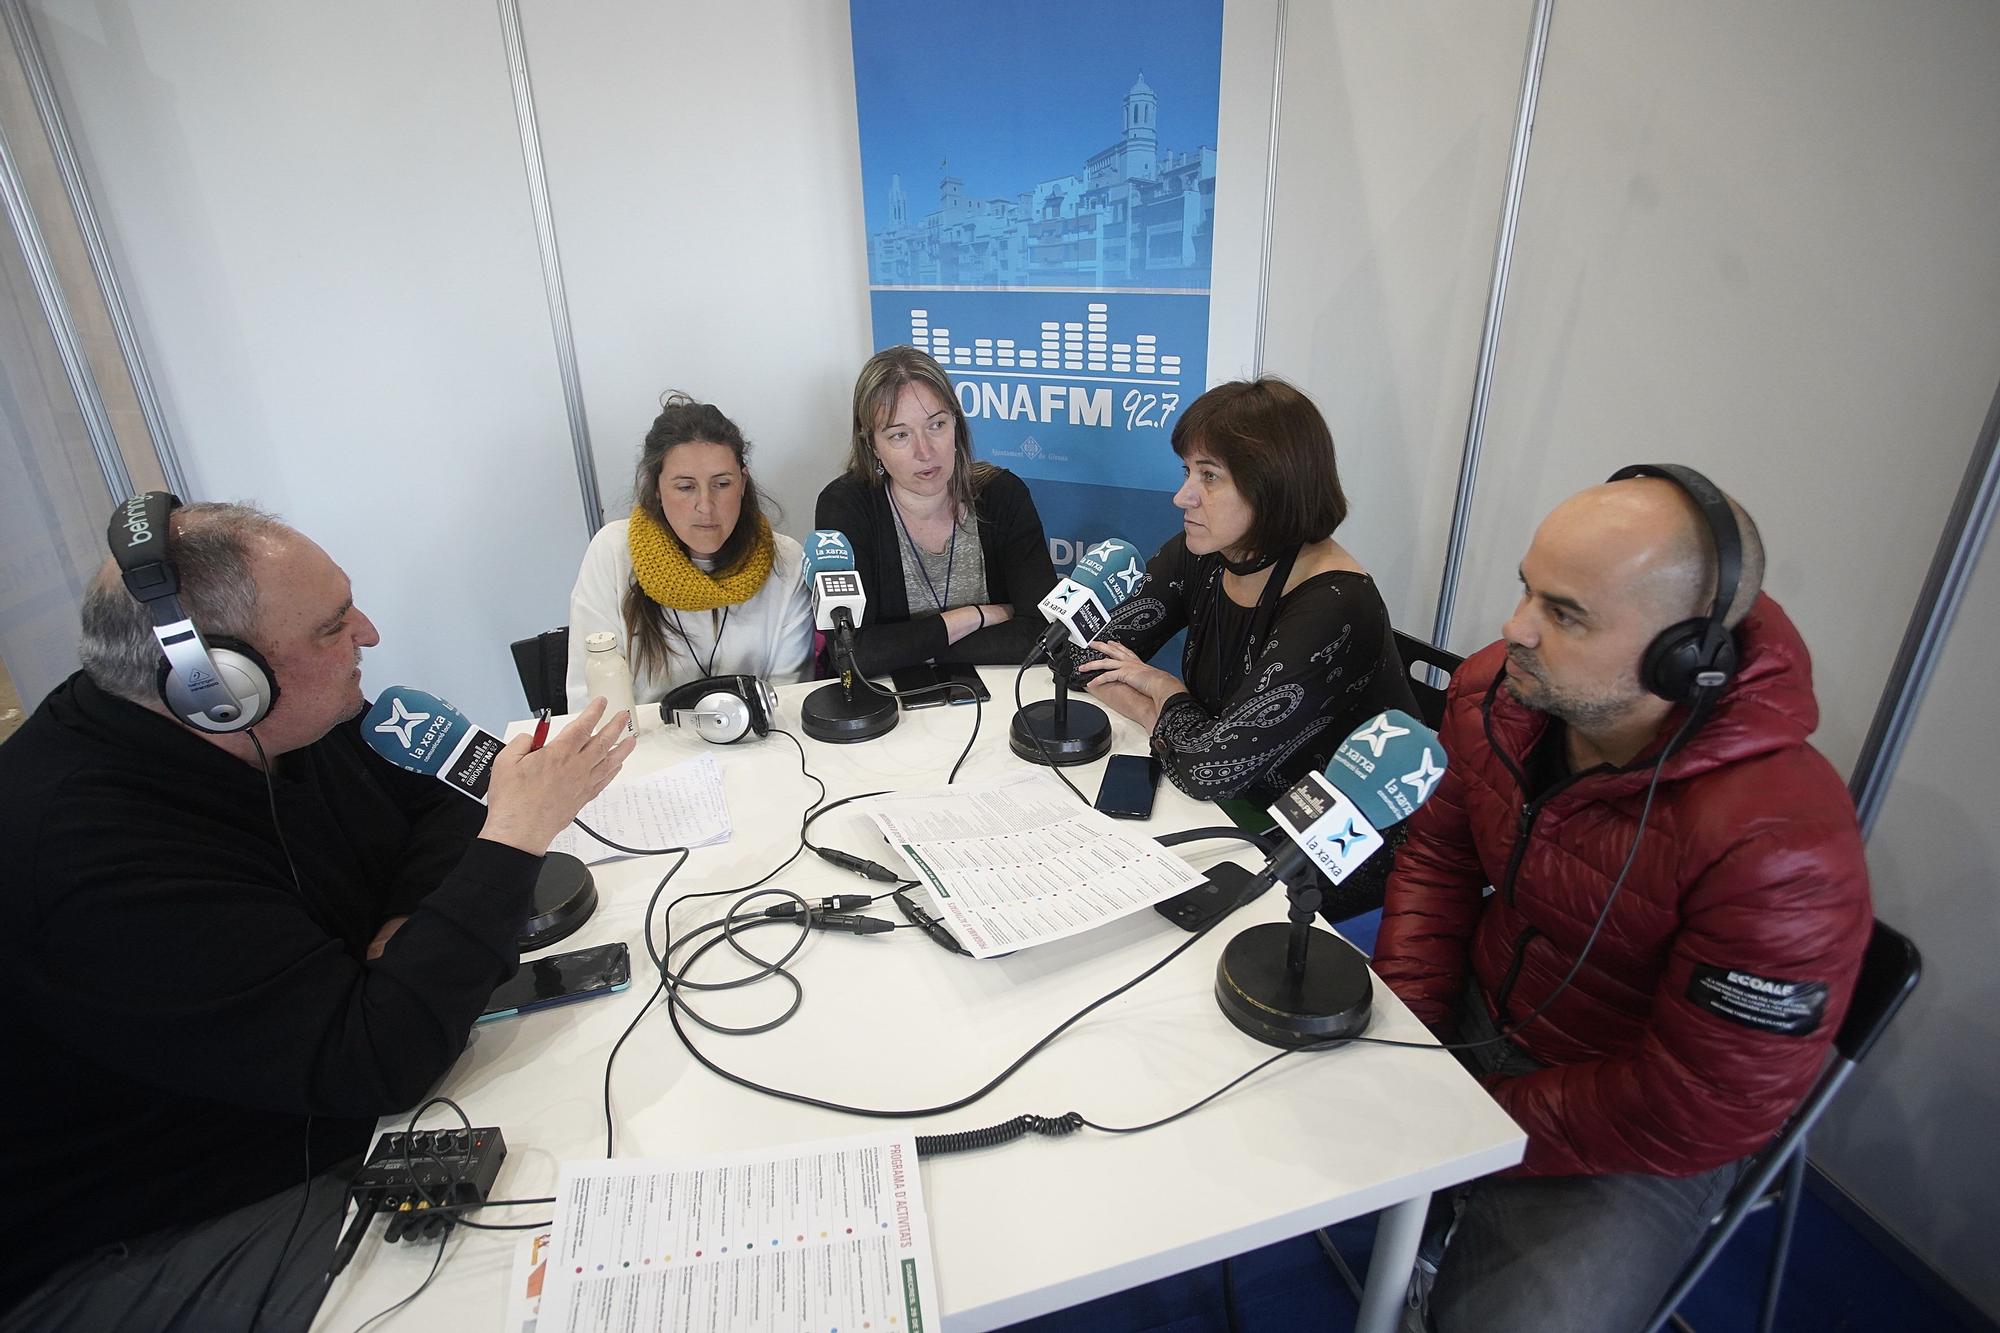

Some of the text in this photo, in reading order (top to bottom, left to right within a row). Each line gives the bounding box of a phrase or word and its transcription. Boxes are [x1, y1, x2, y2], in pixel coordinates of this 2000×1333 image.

[1121, 388, 1180, 431] 92.7
[1050, 538, 1101, 566] DI
[1049, 603, 1067, 616] xarxa
[409, 746, 425, 759] la
[420, 715, 446, 747] xarxa
[443, 721, 454, 733] local
[1347, 748, 1376, 774] xarxa
[1384, 777, 1397, 795] la
[1305, 835, 1319, 853] la
[1315, 848, 1343, 878] xarxa
[1727, 971, 1795, 997] ECOALF
[890, 1144, 905, 1190] PROGRAMA
